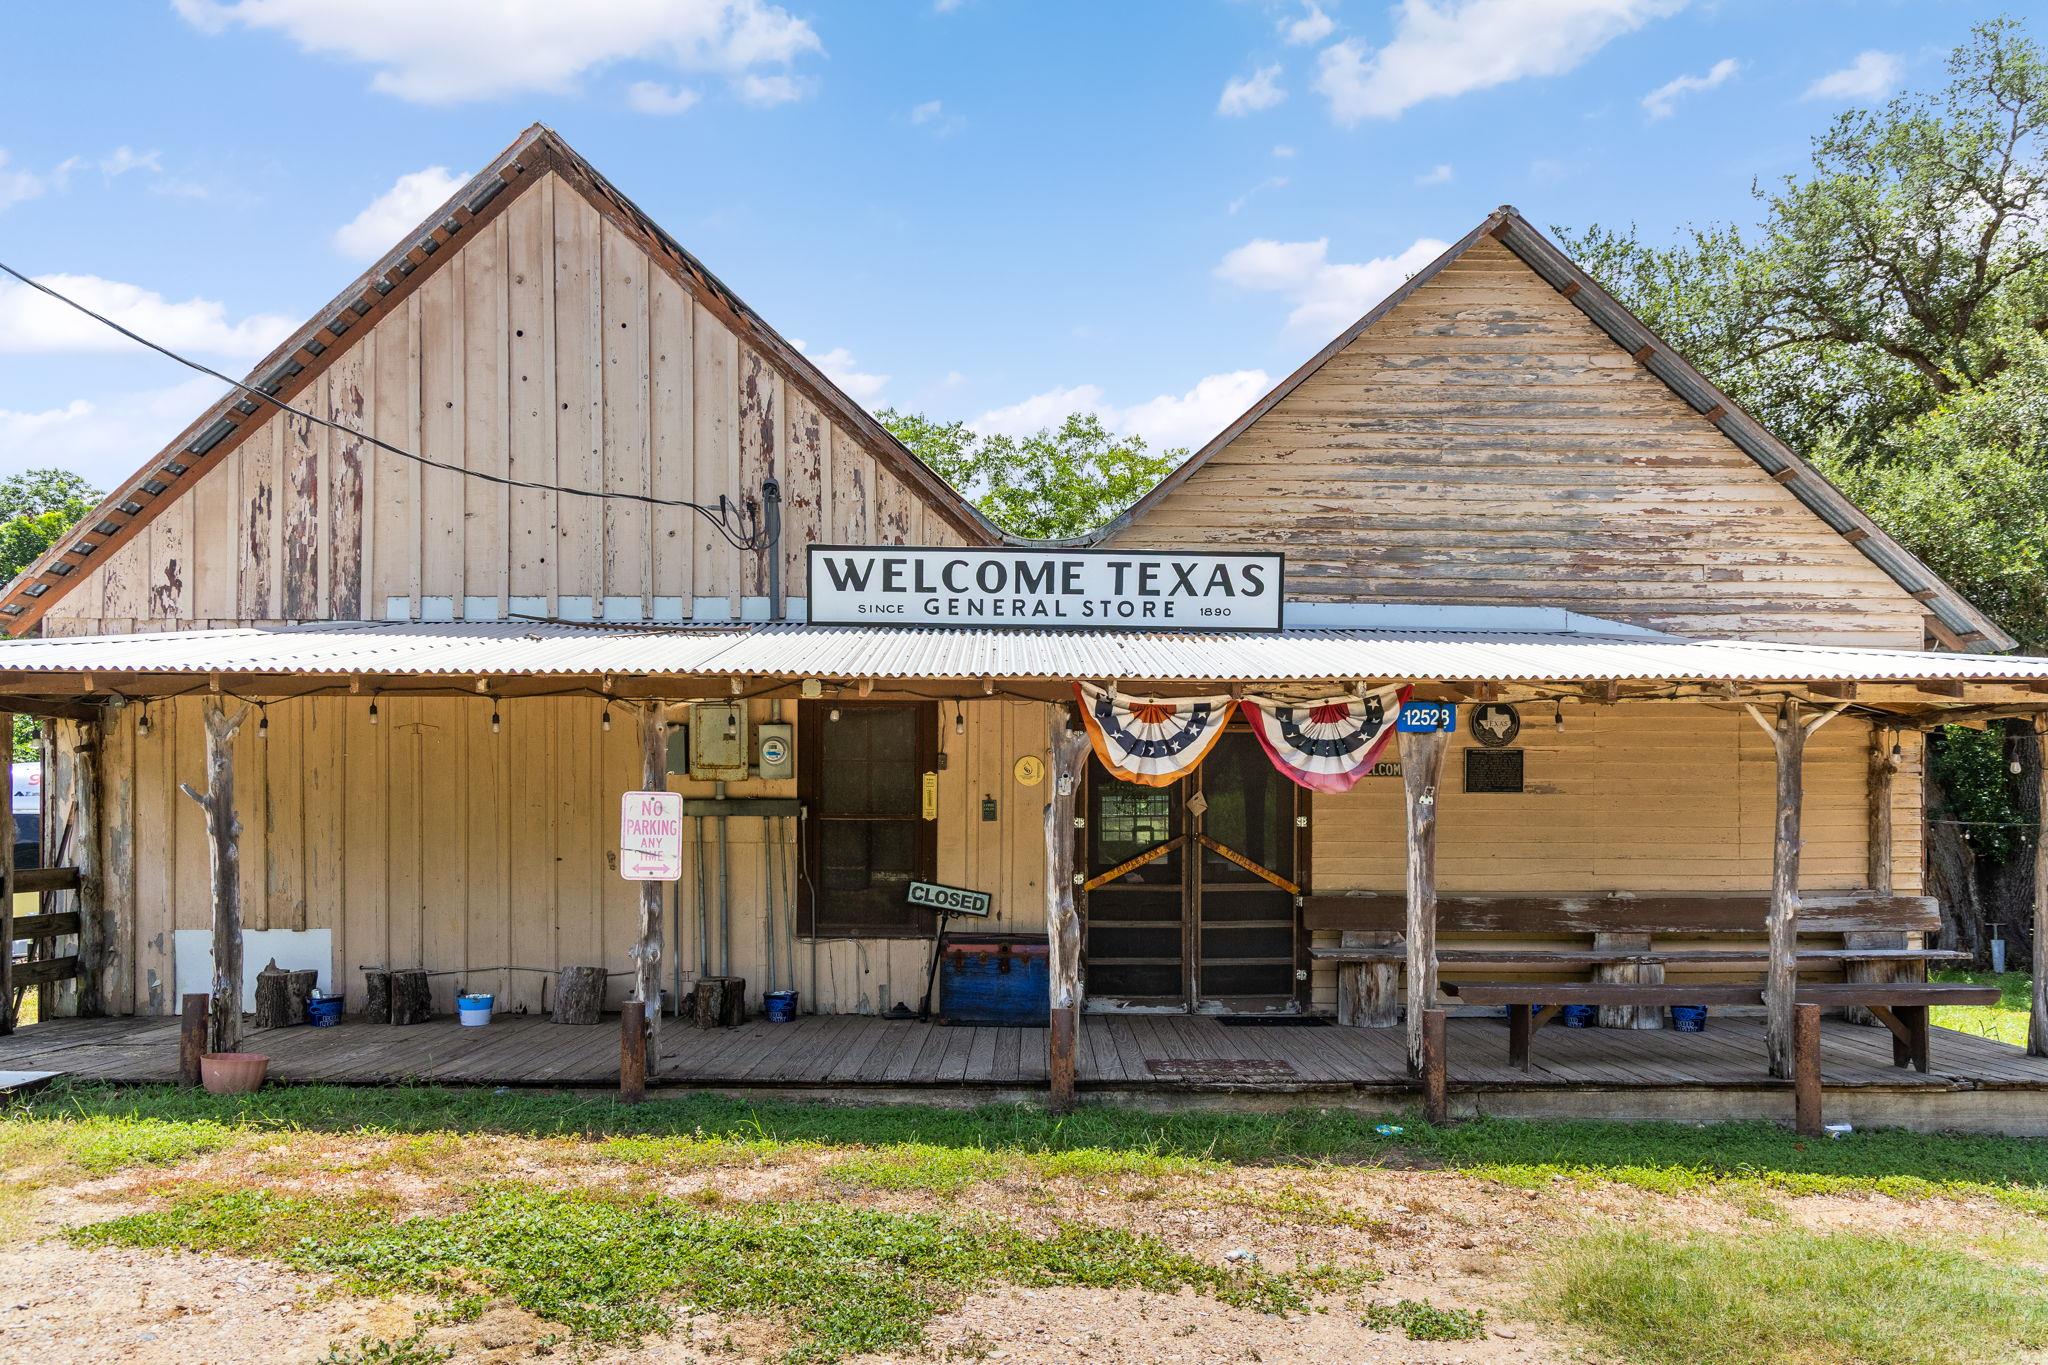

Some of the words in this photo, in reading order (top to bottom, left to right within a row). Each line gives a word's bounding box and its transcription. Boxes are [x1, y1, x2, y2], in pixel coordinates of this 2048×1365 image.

[823, 556, 1085, 596] WELCOME
[1107, 561, 1265, 598] TEXAS
[858, 603, 905, 614] SINCE
[924, 598, 1067, 618] GENERAL
[1082, 600, 1175, 618] STORE
[1199, 606, 1232, 617] 1890
[1404, 709, 1450, 726] 12528
[1485, 719, 1509, 728] TEXAS
[1367, 763, 1402, 776] LCOM
[641, 800, 663, 817] NO
[626, 819, 678, 836] PARKING
[640, 837, 663, 849] ANY
[911, 885, 986, 912] CLOSED
